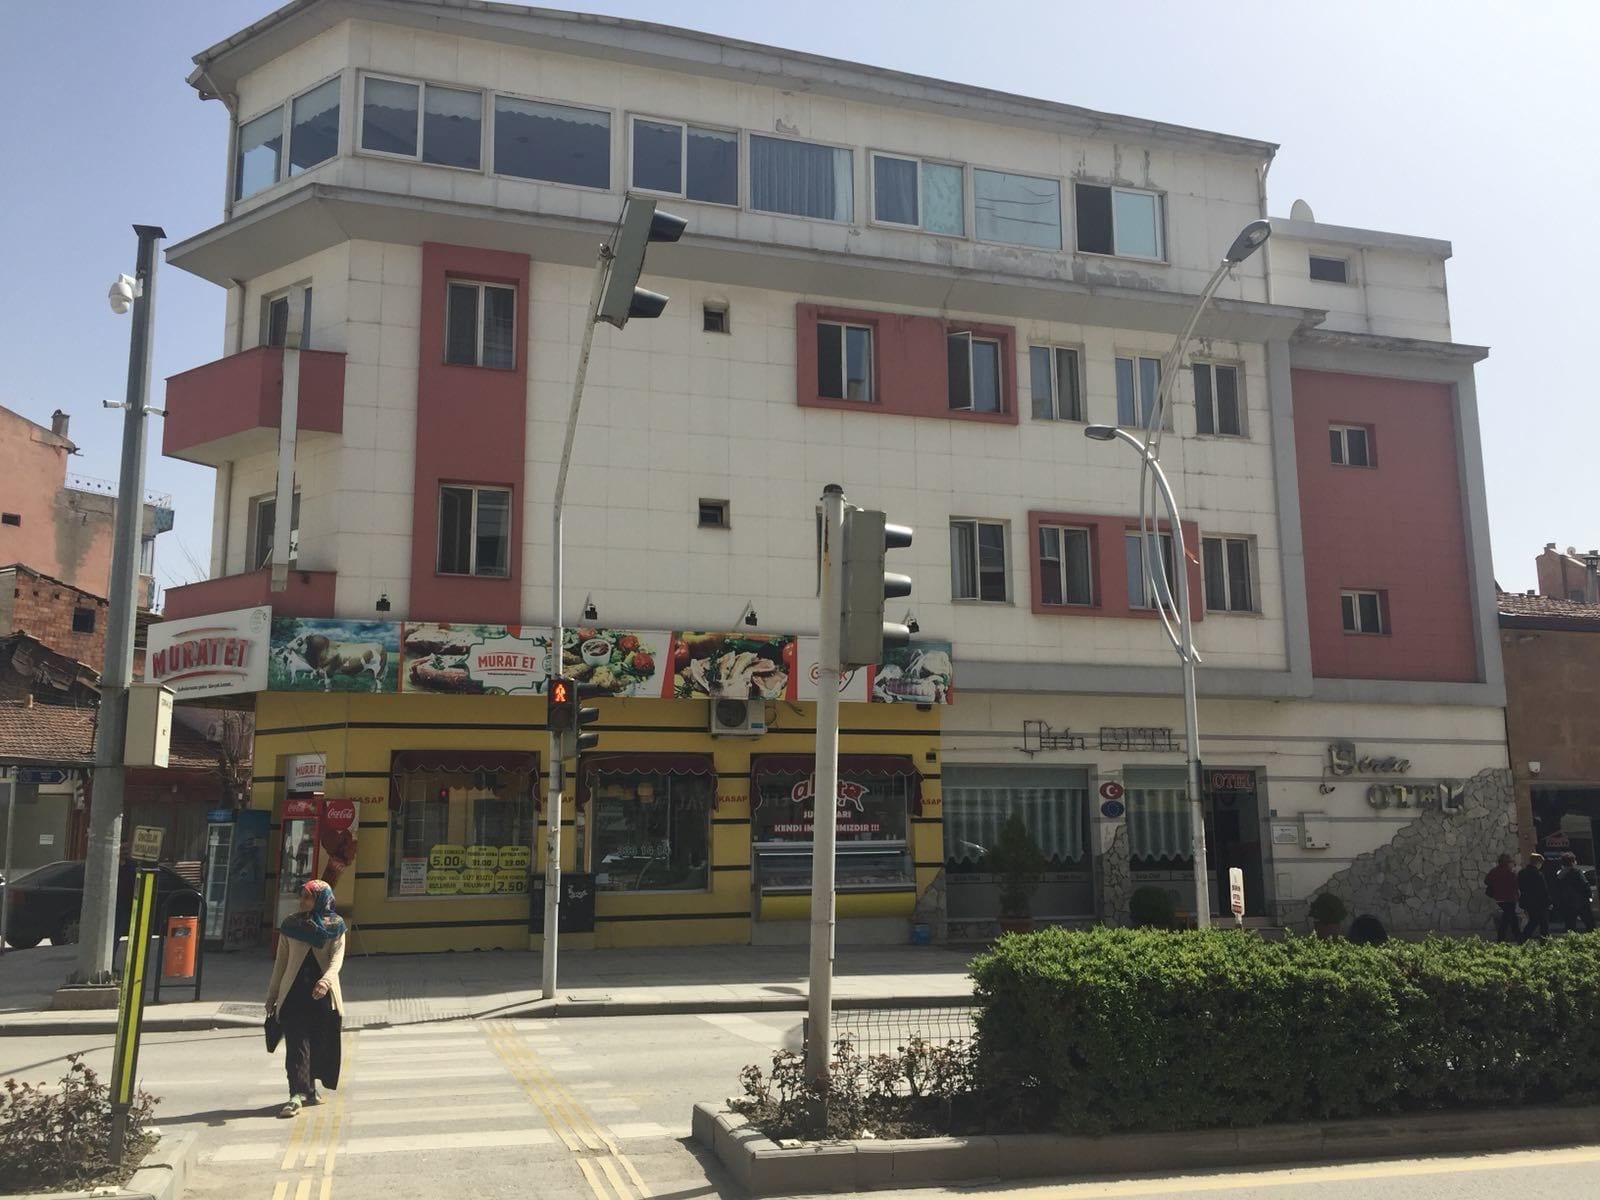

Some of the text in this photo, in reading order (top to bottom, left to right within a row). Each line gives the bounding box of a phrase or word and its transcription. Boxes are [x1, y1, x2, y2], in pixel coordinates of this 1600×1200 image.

[153, 638, 249, 679] MURAT ET
[477, 655, 518, 668] MURAT
[522, 656, 536, 669] ET
[295, 764, 326, 776] MURAT ET
[1212, 772, 1253, 789] OTEL
[718, 795, 748, 803] KASAP
[1366, 782, 1465, 814] OTEL
[432, 855, 460, 867] 5.00
